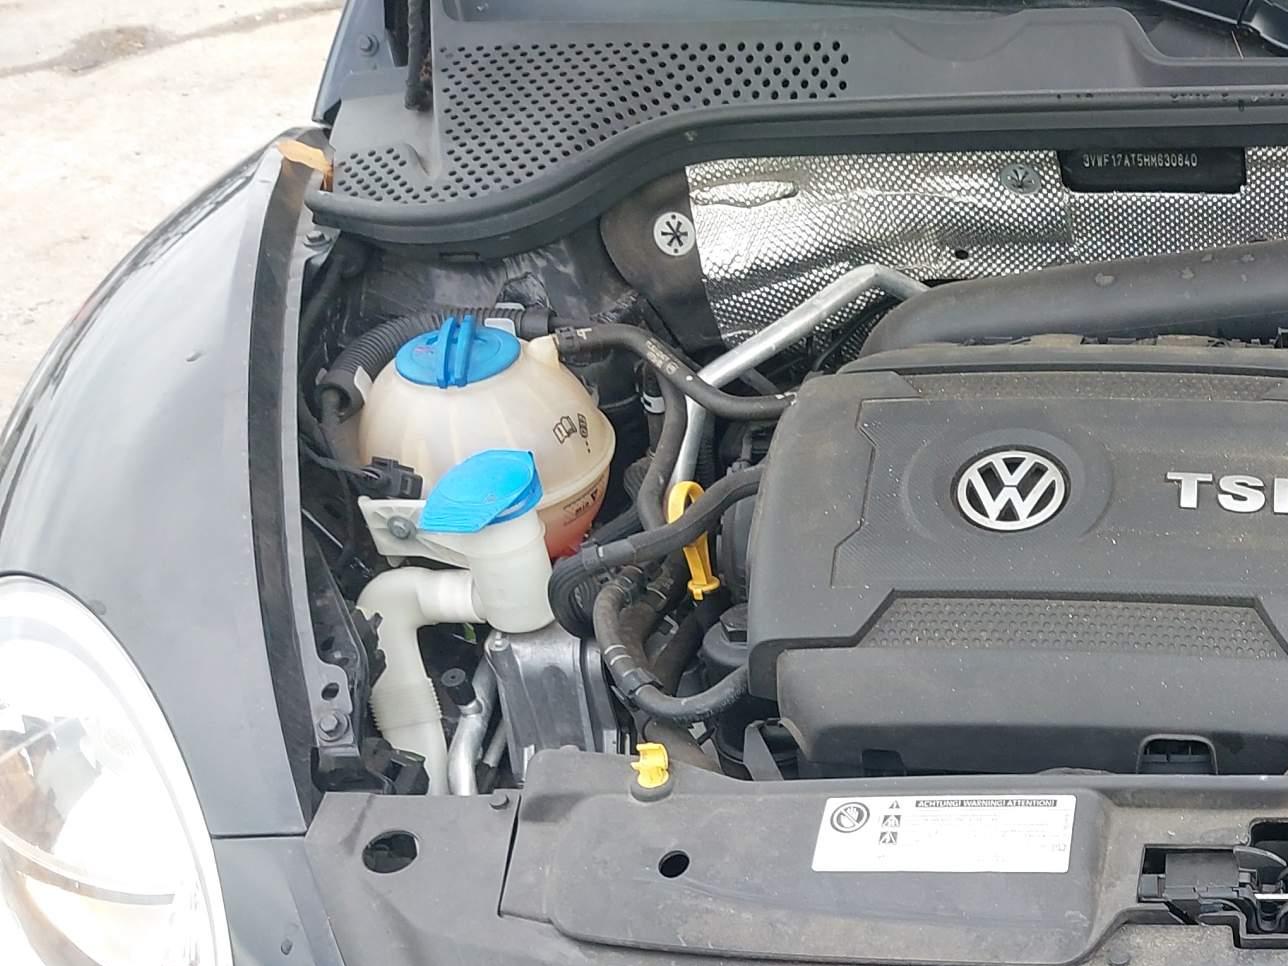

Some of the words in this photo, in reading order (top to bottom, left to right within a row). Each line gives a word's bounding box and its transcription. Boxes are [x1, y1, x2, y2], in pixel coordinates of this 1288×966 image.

[1083, 152, 1198, 167] 3VWF17AT5HM630840
[963, 799, 1006, 807] WARNING!
[1008, 799, 1055, 807] ATTENTION!
